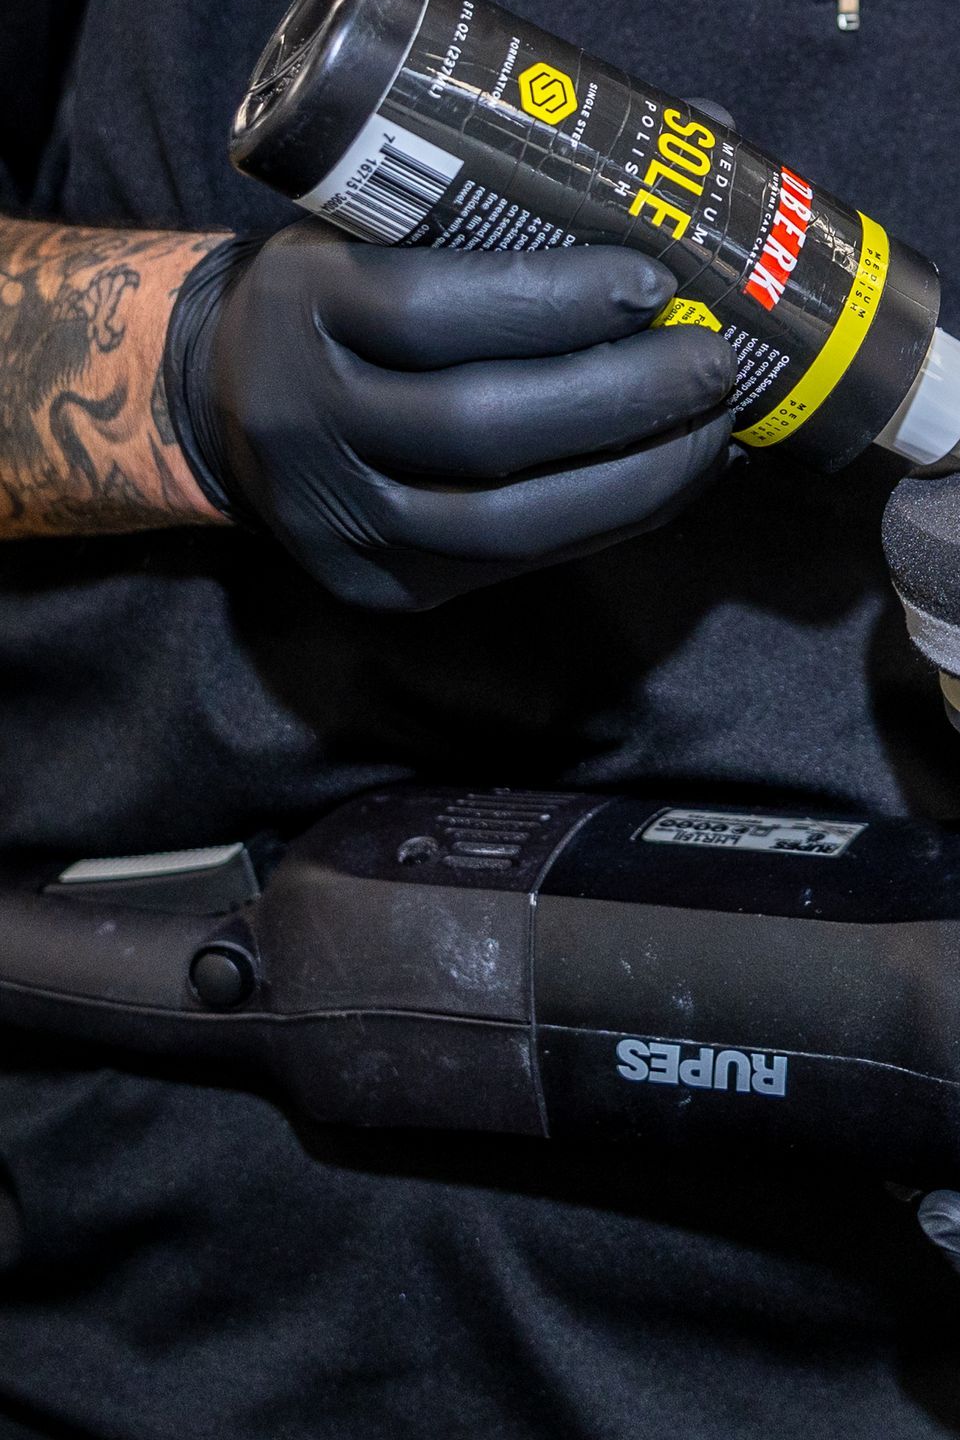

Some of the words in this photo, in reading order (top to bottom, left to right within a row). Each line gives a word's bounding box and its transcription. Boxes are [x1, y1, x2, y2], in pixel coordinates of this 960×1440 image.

[460, 8, 473, 20] FL
[463, 1, 474, 9] 8
[454, 23, 469, 41] OZ.
[487, 37, 520, 109] FORMULATION
[581, 83, 598, 118] SINGLE
[383, 133, 396, 144] 7
[569, 119, 586, 149] STEP
[614, 100, 657, 196] POLISH
[346, 159, 377, 190] 16715
[629, 109, 715, 240] SOLE
[453, 180, 475, 203] towel.
[461, 186, 485, 217] residue
[482, 193, 498, 210] fine
[691, 142, 734, 244] MEDIUM
[768, 172, 779, 209] SUPREME
[488, 198, 507, 222] areas
[507, 205, 518, 217] on
[448, 217, 464, 232] with
[466, 215, 482, 230] film
[477, 222, 491, 238] and
[483, 217, 510, 248] sections
[500, 209, 530, 249] pea-sized
[527, 217, 542, 233] 4-6
[760, 213, 771, 233] CAR
[526, 232, 546, 253] direc
[748, 172, 813, 305] OBERK
[746, 237, 762, 265] CARE
[850, 248, 873, 311] POLISH
[858, 252, 881, 318] MEDIUM
[682, 306, 696, 320] this
[755, 343, 769, 357] the
[768, 349, 780, 362] for
[755, 361, 769, 376] one
[768, 355, 790, 379] Oberk
[741, 376, 757, 391] step
[755, 378, 771, 393] Sole
[740, 397, 754, 408] the
[616, 1039, 788, 1097] RUPES
